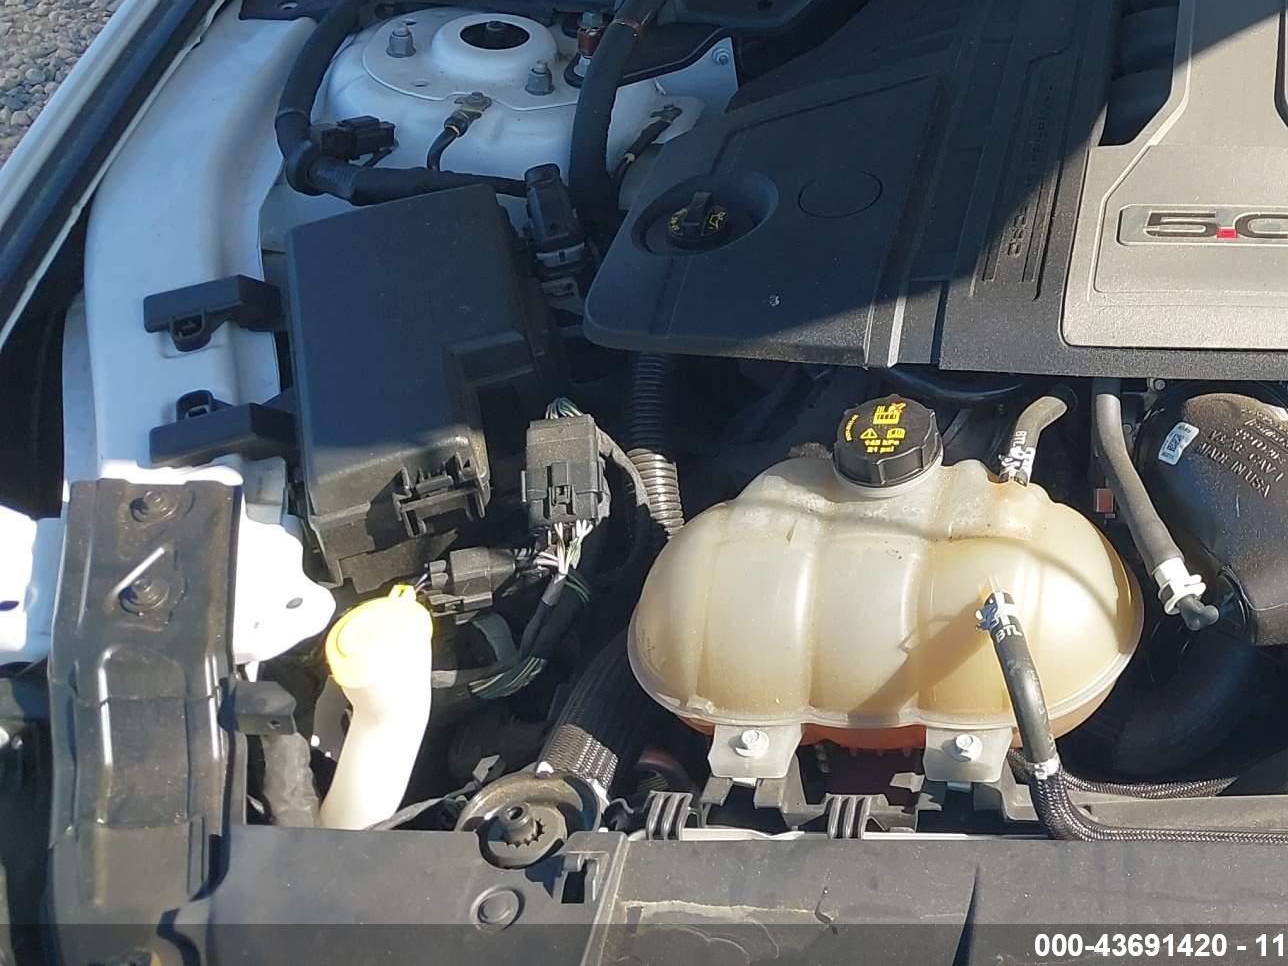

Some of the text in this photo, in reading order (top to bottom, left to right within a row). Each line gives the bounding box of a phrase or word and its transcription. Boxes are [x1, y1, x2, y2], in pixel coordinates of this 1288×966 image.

[1230, 460, 1247, 475] IN
[1245, 470, 1271, 498] USA
[995, 624, 1023, 644] BTL
